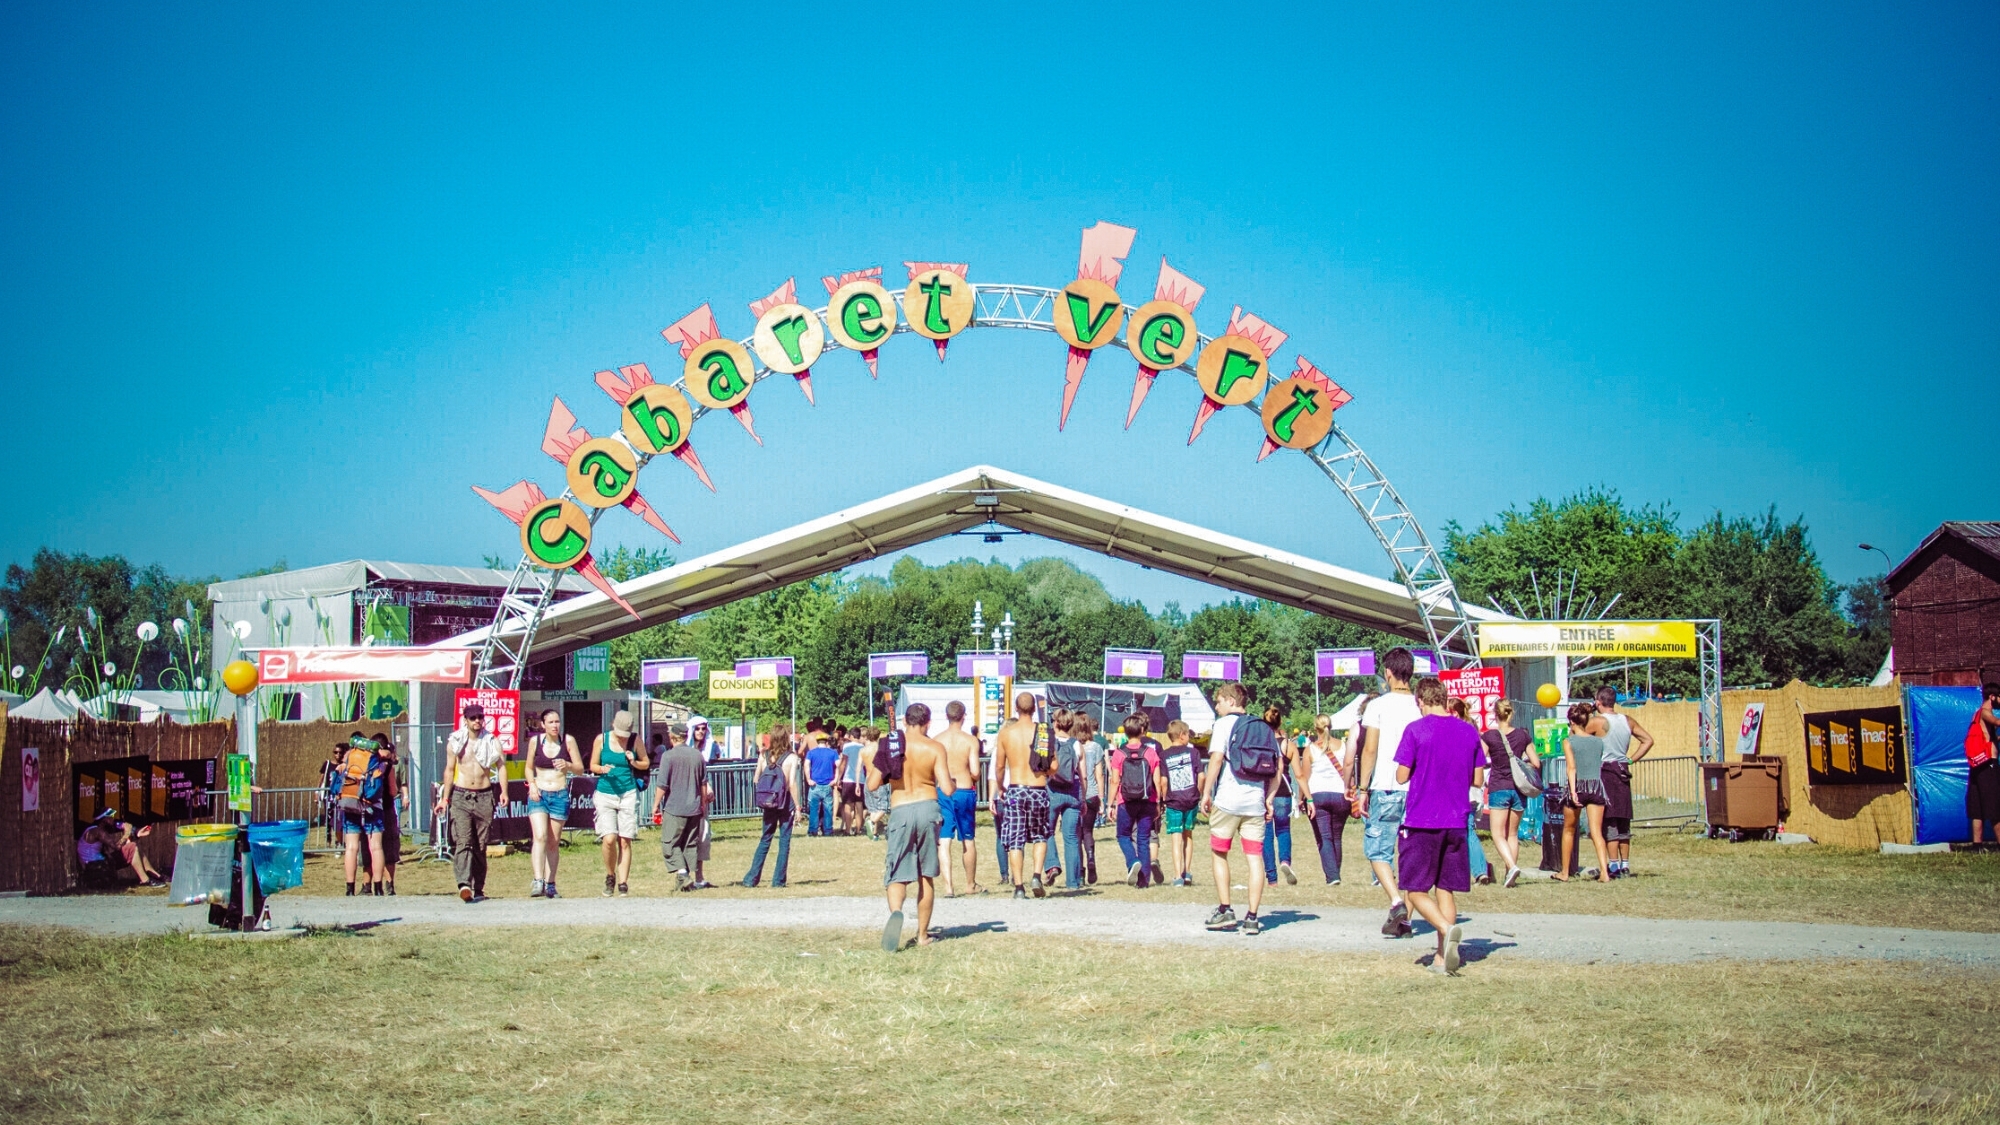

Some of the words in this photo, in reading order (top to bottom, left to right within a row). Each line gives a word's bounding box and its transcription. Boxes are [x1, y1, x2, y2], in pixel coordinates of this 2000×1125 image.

[526, 275, 953, 564] cabaret
[1064, 290, 1320, 443] vert
[1559, 626, 1615, 641] ENTRÉE
[1489, 643, 1548, 652] PARTENAIRES
[1557, 643, 1585, 651] MEDIA
[1594, 643, 1614, 651] PMR
[1623, 643, 1687, 652] ORGANISATION
[1444, 676, 1500, 688] INTERDITS
[1460, 671, 1481, 679] SONT
[712, 679, 775, 690] CONSIGNES
[477, 691, 498, 699] SONT
[459, 698, 515, 708] INTERDITS
[1809, 731, 1822, 746] fnac
[1830, 730, 1849, 745] fnac
[1861, 728, 1886, 743] fnac
[105, 779, 120, 794] fnac
[128, 775, 142, 790] fnac
[151, 773, 166, 789] fnac
[80, 782, 95, 798] fnac
